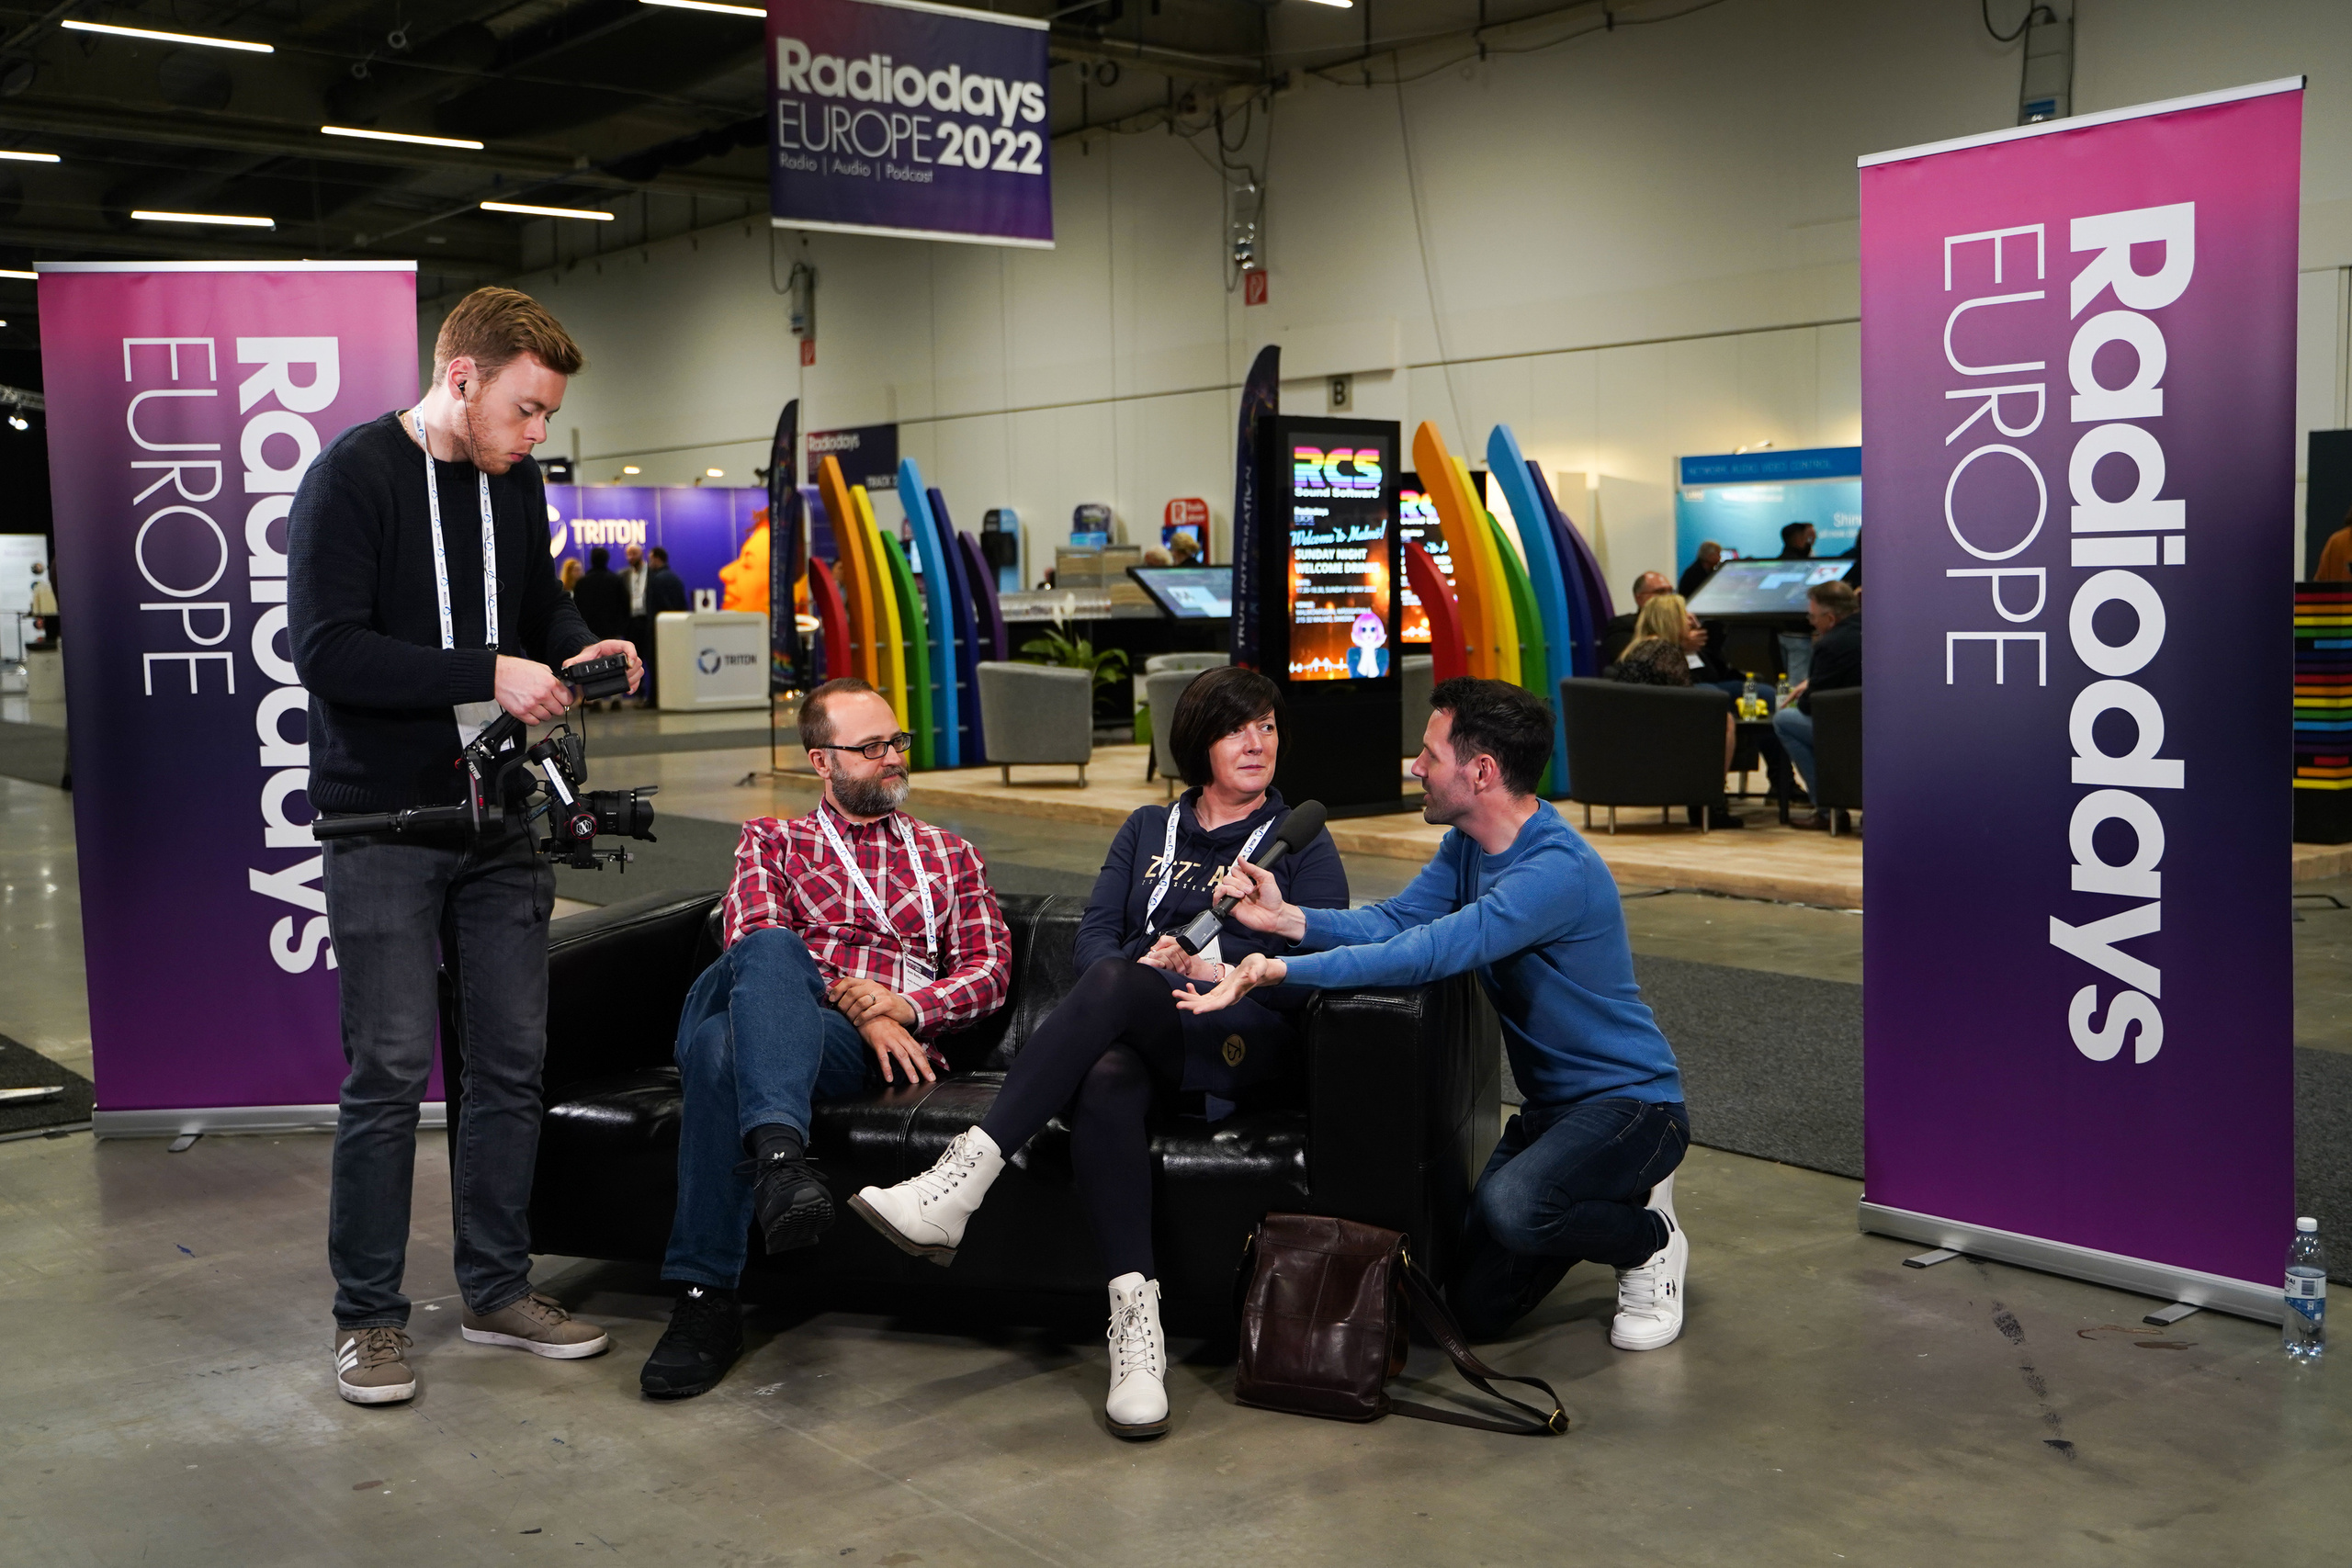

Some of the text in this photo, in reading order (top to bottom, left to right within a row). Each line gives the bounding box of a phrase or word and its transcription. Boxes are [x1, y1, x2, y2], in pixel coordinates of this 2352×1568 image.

[775, 36, 1046, 128] Radiodays
[778, 98, 1044, 175] EUROPE 2022
[780, 151, 818, 172] Radio
[831, 157, 871, 178] Audio
[885, 164, 933, 183] Podcast
[1333, 380, 1346, 405] B
[808, 433, 861, 452] Radiodays
[1943, 222, 2049, 687] EUROPE
[1293, 446, 1384, 490] RCS
[1294, 486, 1331, 498] Sound
[122, 336, 236, 697] EUROPE
[570, 518, 647, 545] TRITON
[1289, 529, 1336, 547] Welcome
[1332, 526, 1348, 543] to
[1294, 547, 1368, 560] SUNDAY NIGHT
[1294, 561, 1381, 574] WELCOME DRINKS
[1238, 601, 1247, 649] TRUE
[2049, 200, 2196, 1065] Radiodays
[724, 653, 758, 666] TRITON
